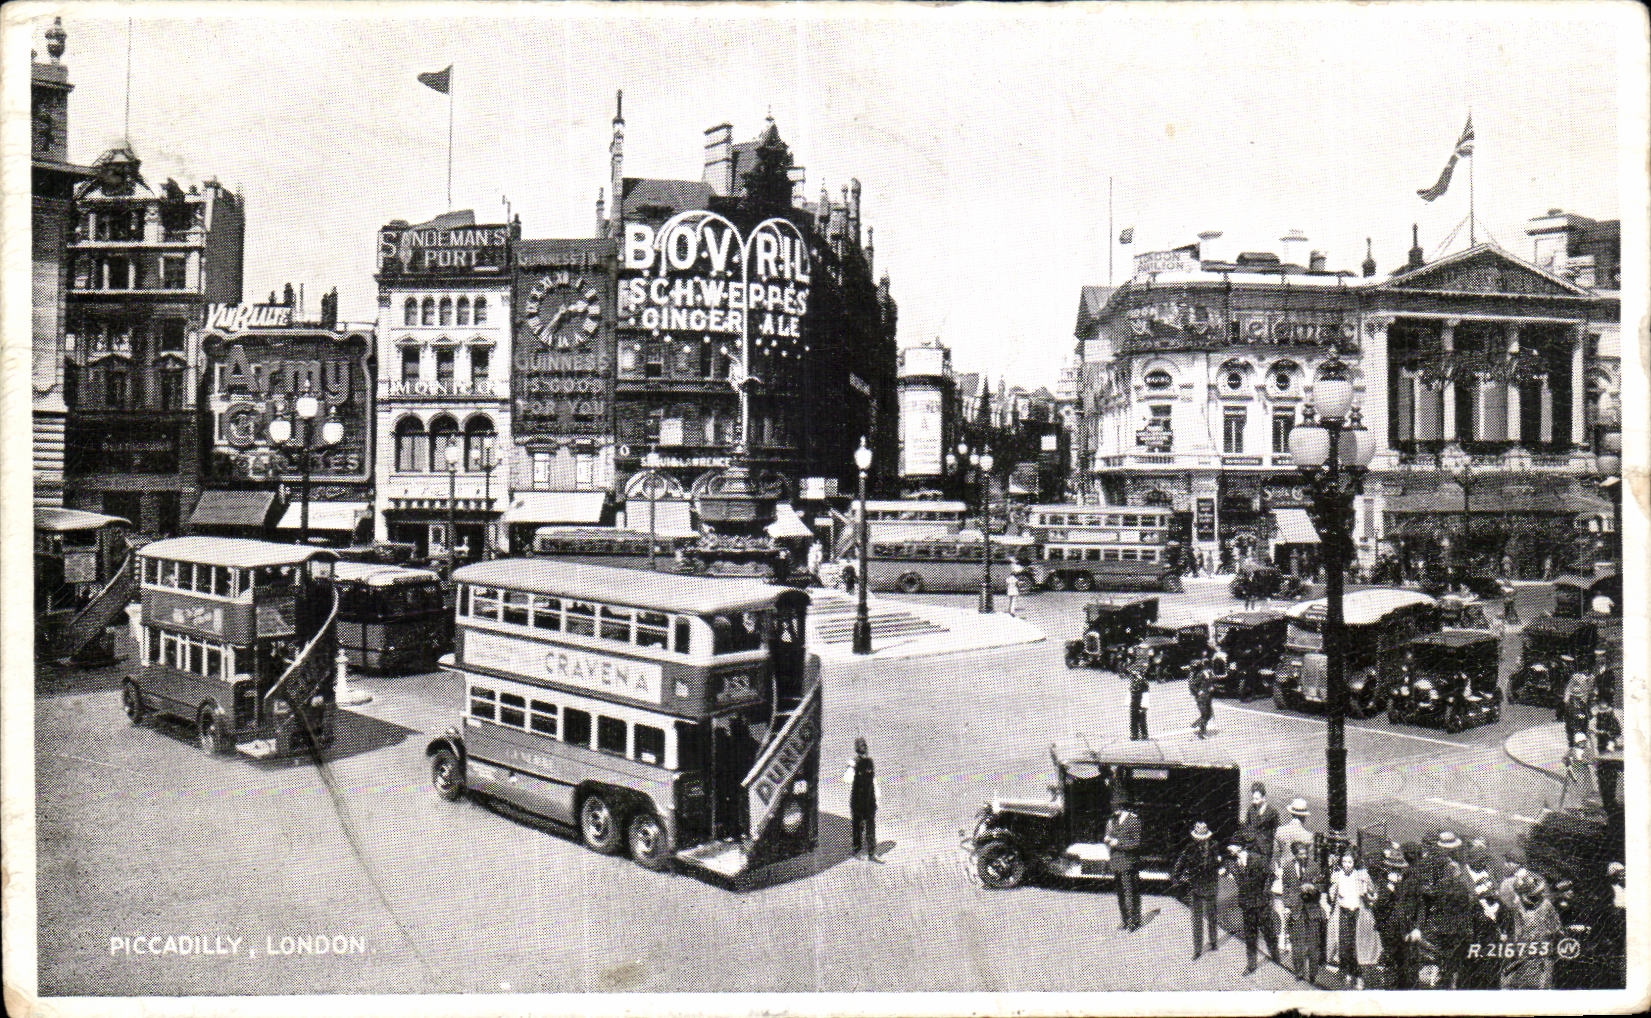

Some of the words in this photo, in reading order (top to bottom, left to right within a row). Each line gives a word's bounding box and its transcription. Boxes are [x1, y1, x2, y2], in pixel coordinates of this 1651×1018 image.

[424, 249, 480, 268] PORT
[624, 222, 809, 284] BOVRIL
[642, 307, 742, 332] GINGER
[762, 313, 801, 337] ALE
[219, 343, 350, 405] Army
[514, 353, 610, 371] GUINNESS
[548, 378, 603, 392] GOOD
[567, 399, 606, 415] YOU
[544, 651, 629, 686] CRAVEN
[635, 672, 649, 692] A
